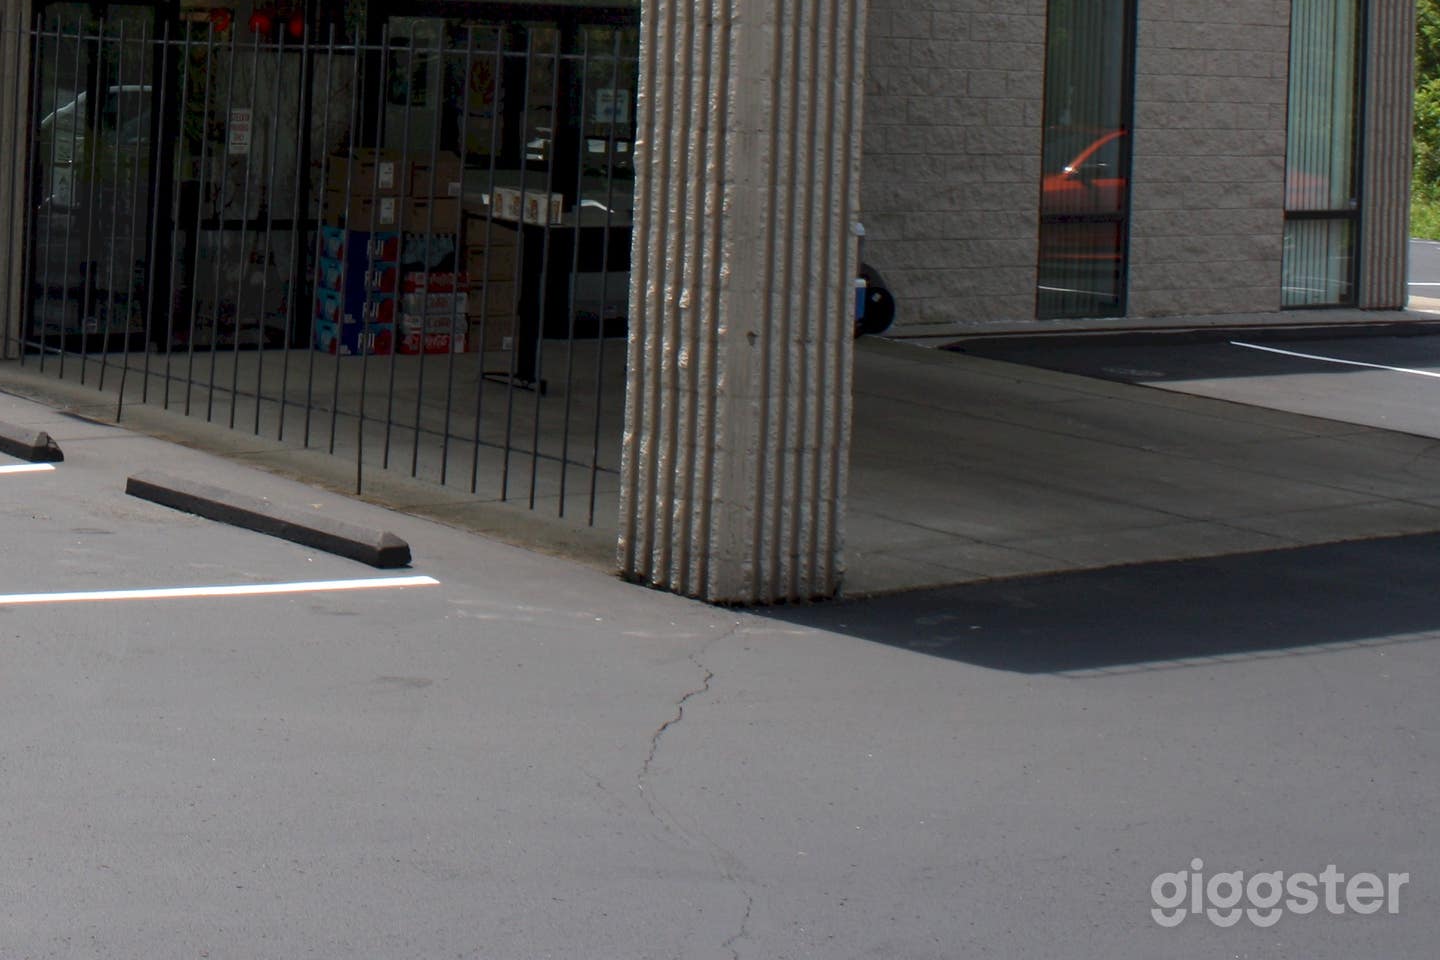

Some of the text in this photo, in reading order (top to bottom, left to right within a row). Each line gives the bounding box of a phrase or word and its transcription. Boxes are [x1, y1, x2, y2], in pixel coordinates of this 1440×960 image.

[366, 239, 384, 257] FJI
[364, 270, 382, 288] FJI
[361, 301, 380, 319] FJI
[357, 332, 375, 350] FJI
